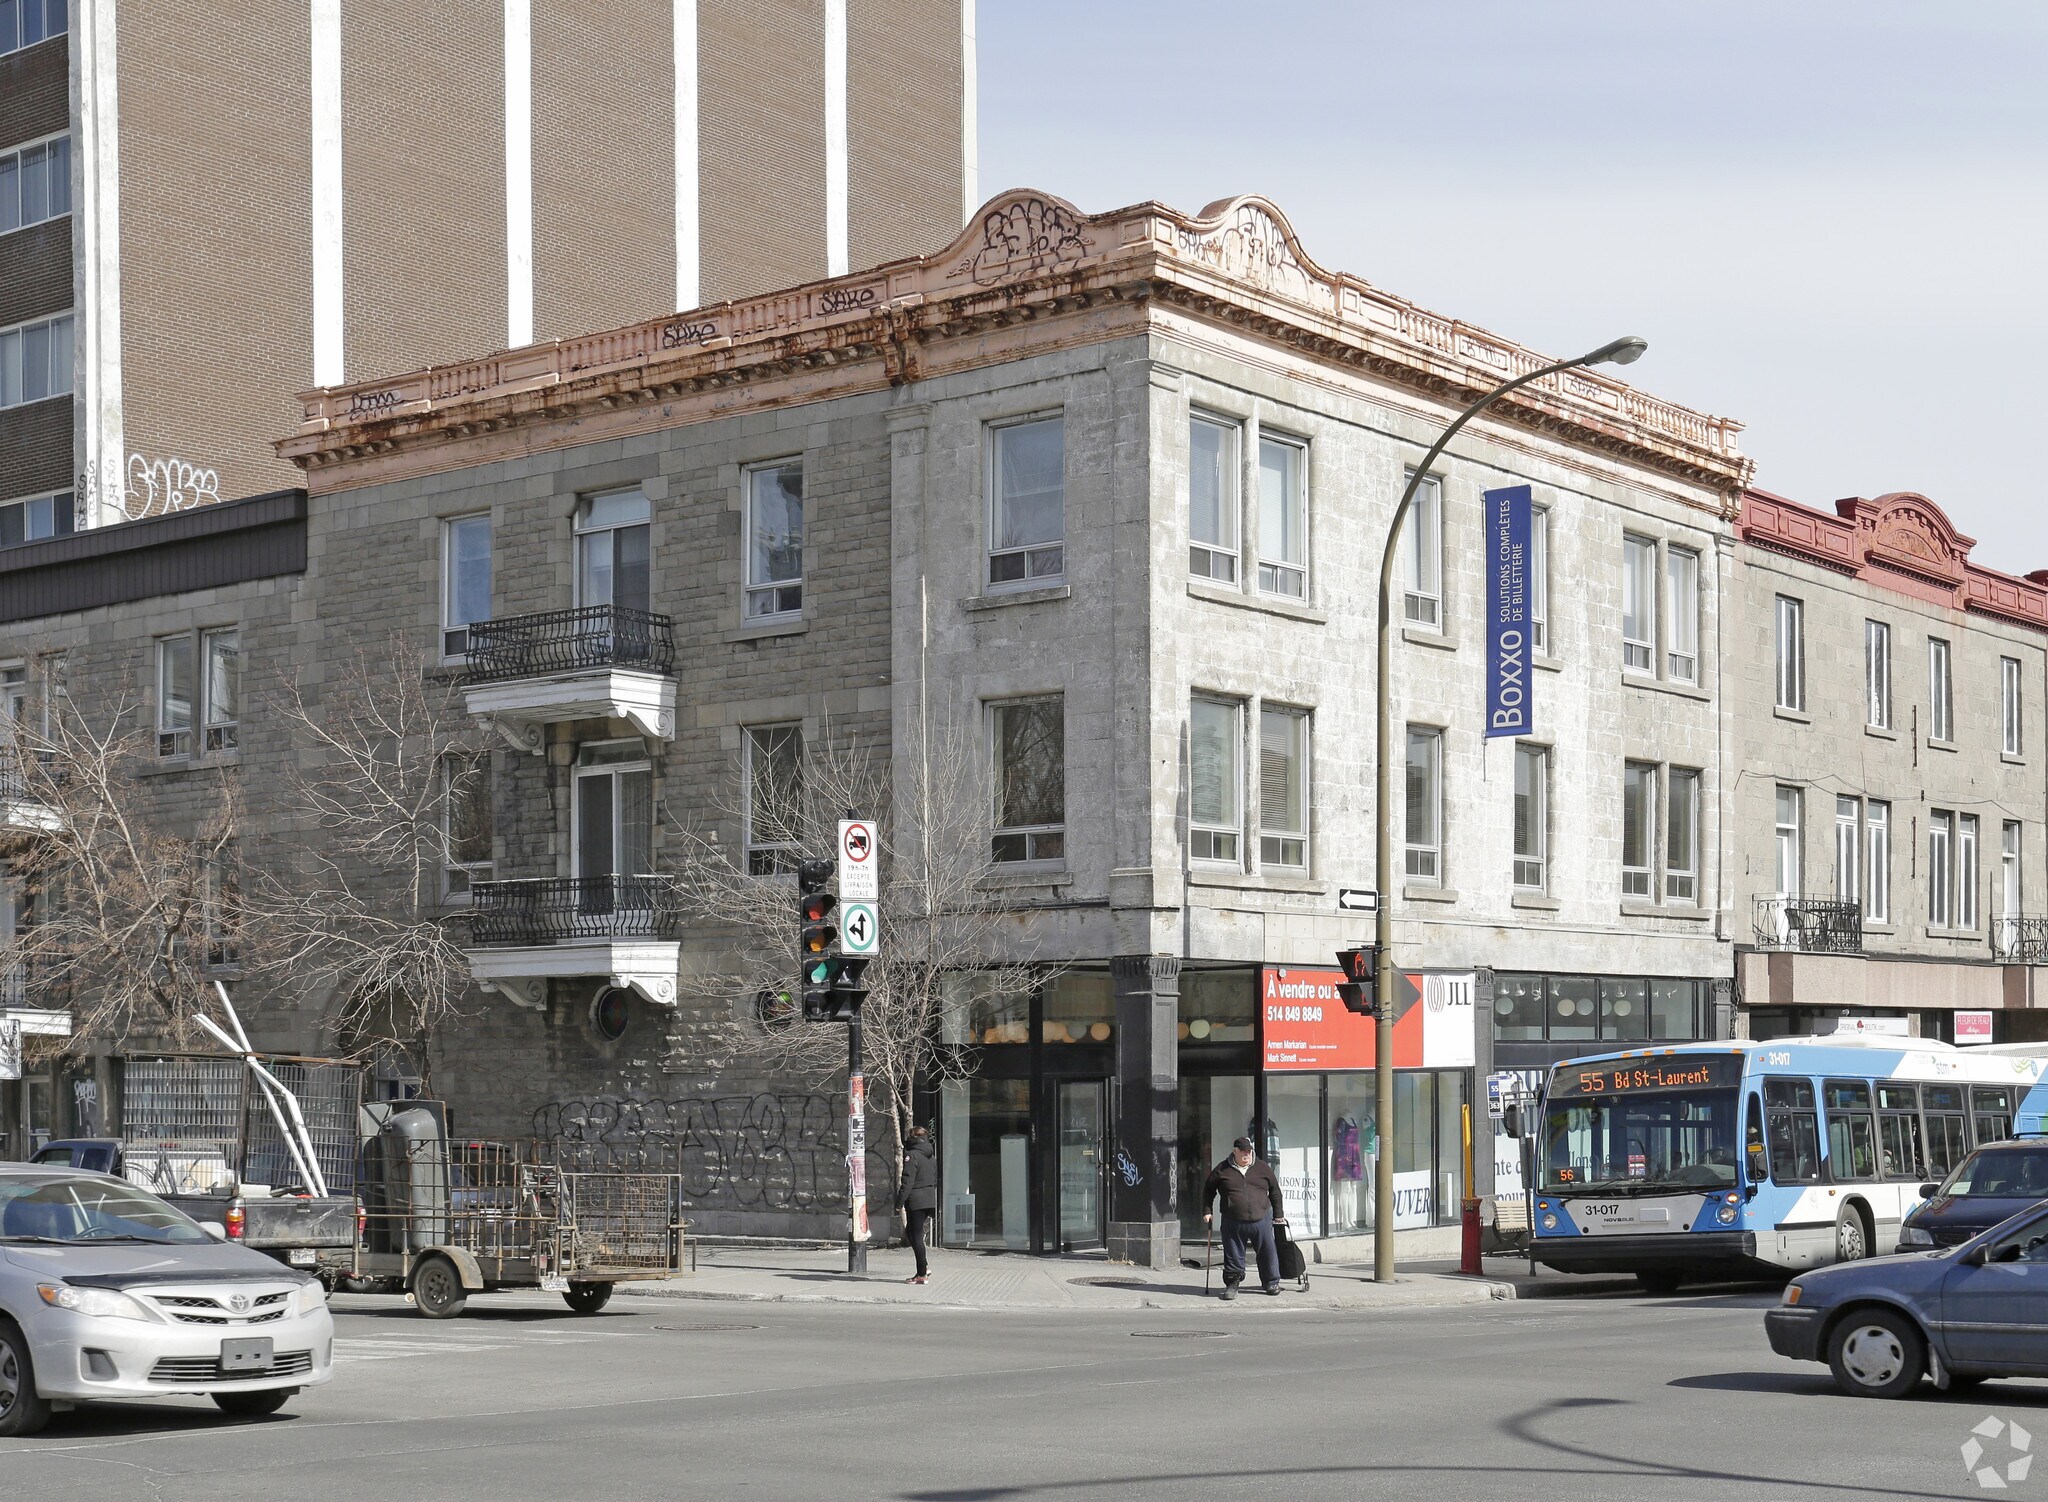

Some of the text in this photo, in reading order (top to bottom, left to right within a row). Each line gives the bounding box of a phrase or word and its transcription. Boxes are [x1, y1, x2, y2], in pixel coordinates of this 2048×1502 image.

[1498, 499, 1510, 623] SOLUTIONS COMPLÈTES
[1512, 542, 1523, 622] DE BILLETTERIE
[1267, 974, 1276, 998] À
[1278, 980, 1315, 999] vendre
[1318, 984, 1331, 999] ou
[1447, 982, 1471, 1006] JLL
[1267, 1006, 1322, 1022] 514 849 8849
[3, 1025, 17, 1035] US
[1, 1039, 18, 1048] AXI
[1267, 1053, 1279, 1062] Mark
[1769, 1051, 1790, 1066] 31-017
[1580, 1065, 1709, 1092] 55 Bd St-Laurent
[1489, 1101, 1500, 1110] 363
[1560, 1169, 1574, 1181] 56
[1301, 1177, 1316, 1189] DES
[1585, 1204, 1620, 1216] 31-017
